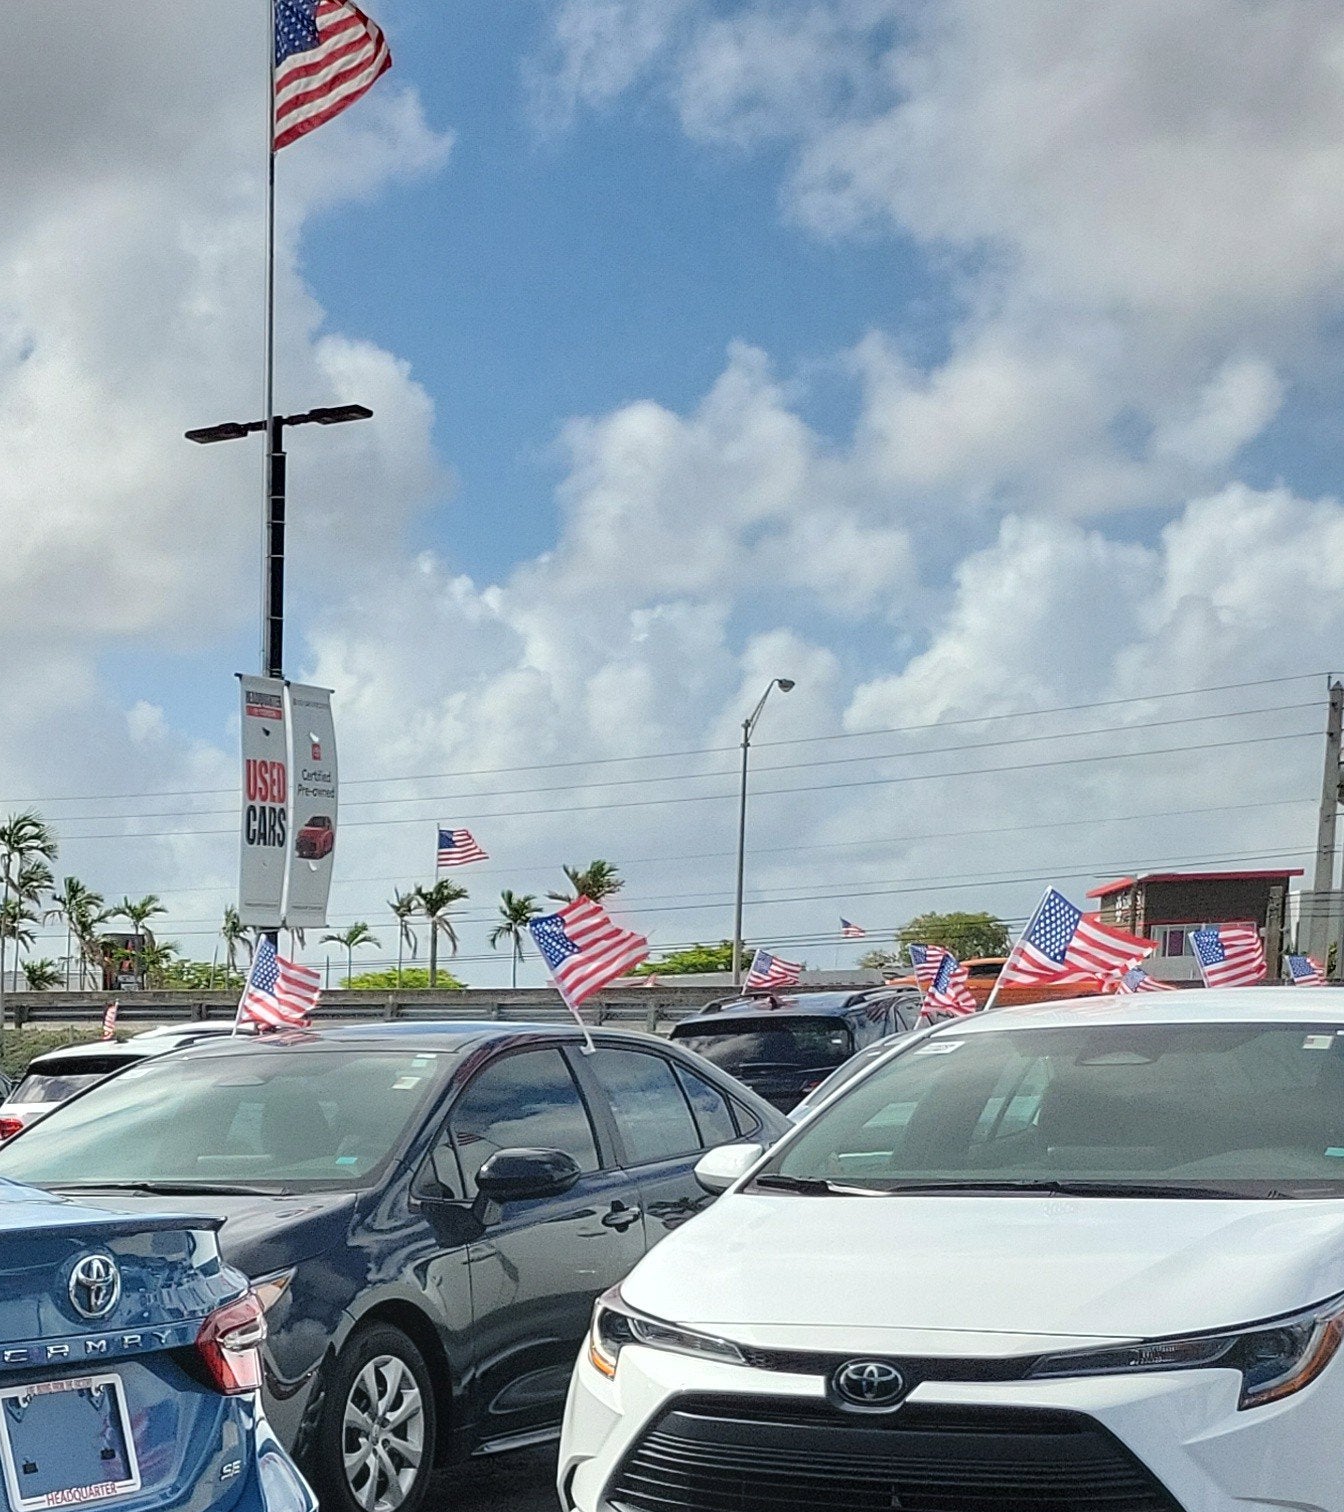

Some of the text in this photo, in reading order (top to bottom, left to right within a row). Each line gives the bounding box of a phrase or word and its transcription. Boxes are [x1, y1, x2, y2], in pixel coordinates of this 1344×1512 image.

[246, 759, 286, 803] USED
[246, 804, 287, 848] CARS
[3, 1329, 172, 1363] CAMRY
[220, 1460, 242, 1481] SE
[46, 1482, 118, 1507] HEADQUARTER
